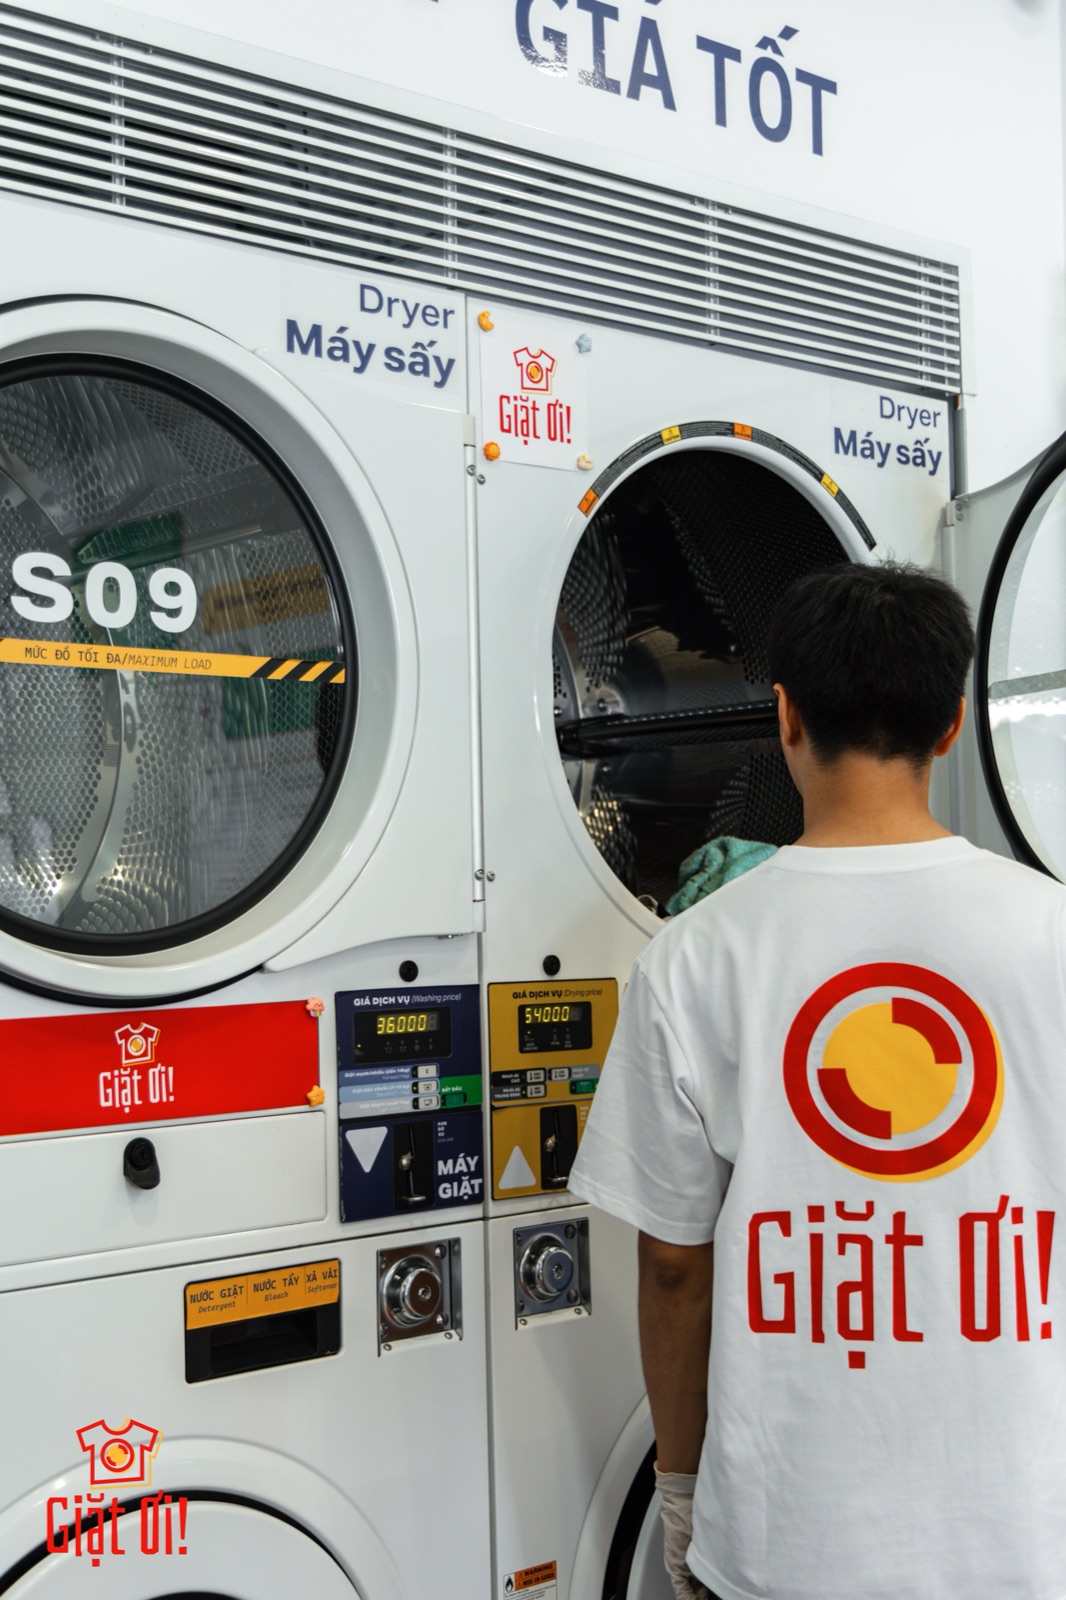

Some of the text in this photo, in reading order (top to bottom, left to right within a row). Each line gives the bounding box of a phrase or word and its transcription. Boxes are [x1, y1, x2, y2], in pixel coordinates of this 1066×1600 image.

[696, 25, 838, 157] TỐT
[359, 283, 455, 329] Dryer
[286, 318, 456, 389] Máy sấy
[499, 394, 541, 445] Giặt
[879, 395, 941, 430] Dryer
[832, 426, 891, 468] Máy
[896, 437, 943, 476] sấy
[11, 551, 198, 634] S09
[24, 646, 48, 660] MỨC
[78, 647, 100, 663] TỐI
[184, 658, 212, 671] LOAD
[353, 992, 462, 1006] GIÁ DỊCH VỤ (Washing price)
[512, 990, 527, 999] GIÁ
[529, 990, 549, 1000] DỊCH
[551, 989, 563, 999] VỤ
[377, 1014, 427, 1035] 36000
[525, 1006, 570, 1024] 54000
[99, 1068, 143, 1114] Giặt
[437, 1152, 479, 1176] MÁY
[438, 1175, 483, 1200] GIẶT
[253, 1272, 299, 1293] NƯỚC TẨY
[306, 1267, 338, 1283] XẢ VẢI
[747, 1200, 924, 1369] Giặt
[190, 1284, 245, 1304] NƯỚC GIẶT
[264, 1291, 289, 1302] Bleach
[307, 1282, 338, 1294] Softener
[198, 1301, 236, 1314] Detergent
